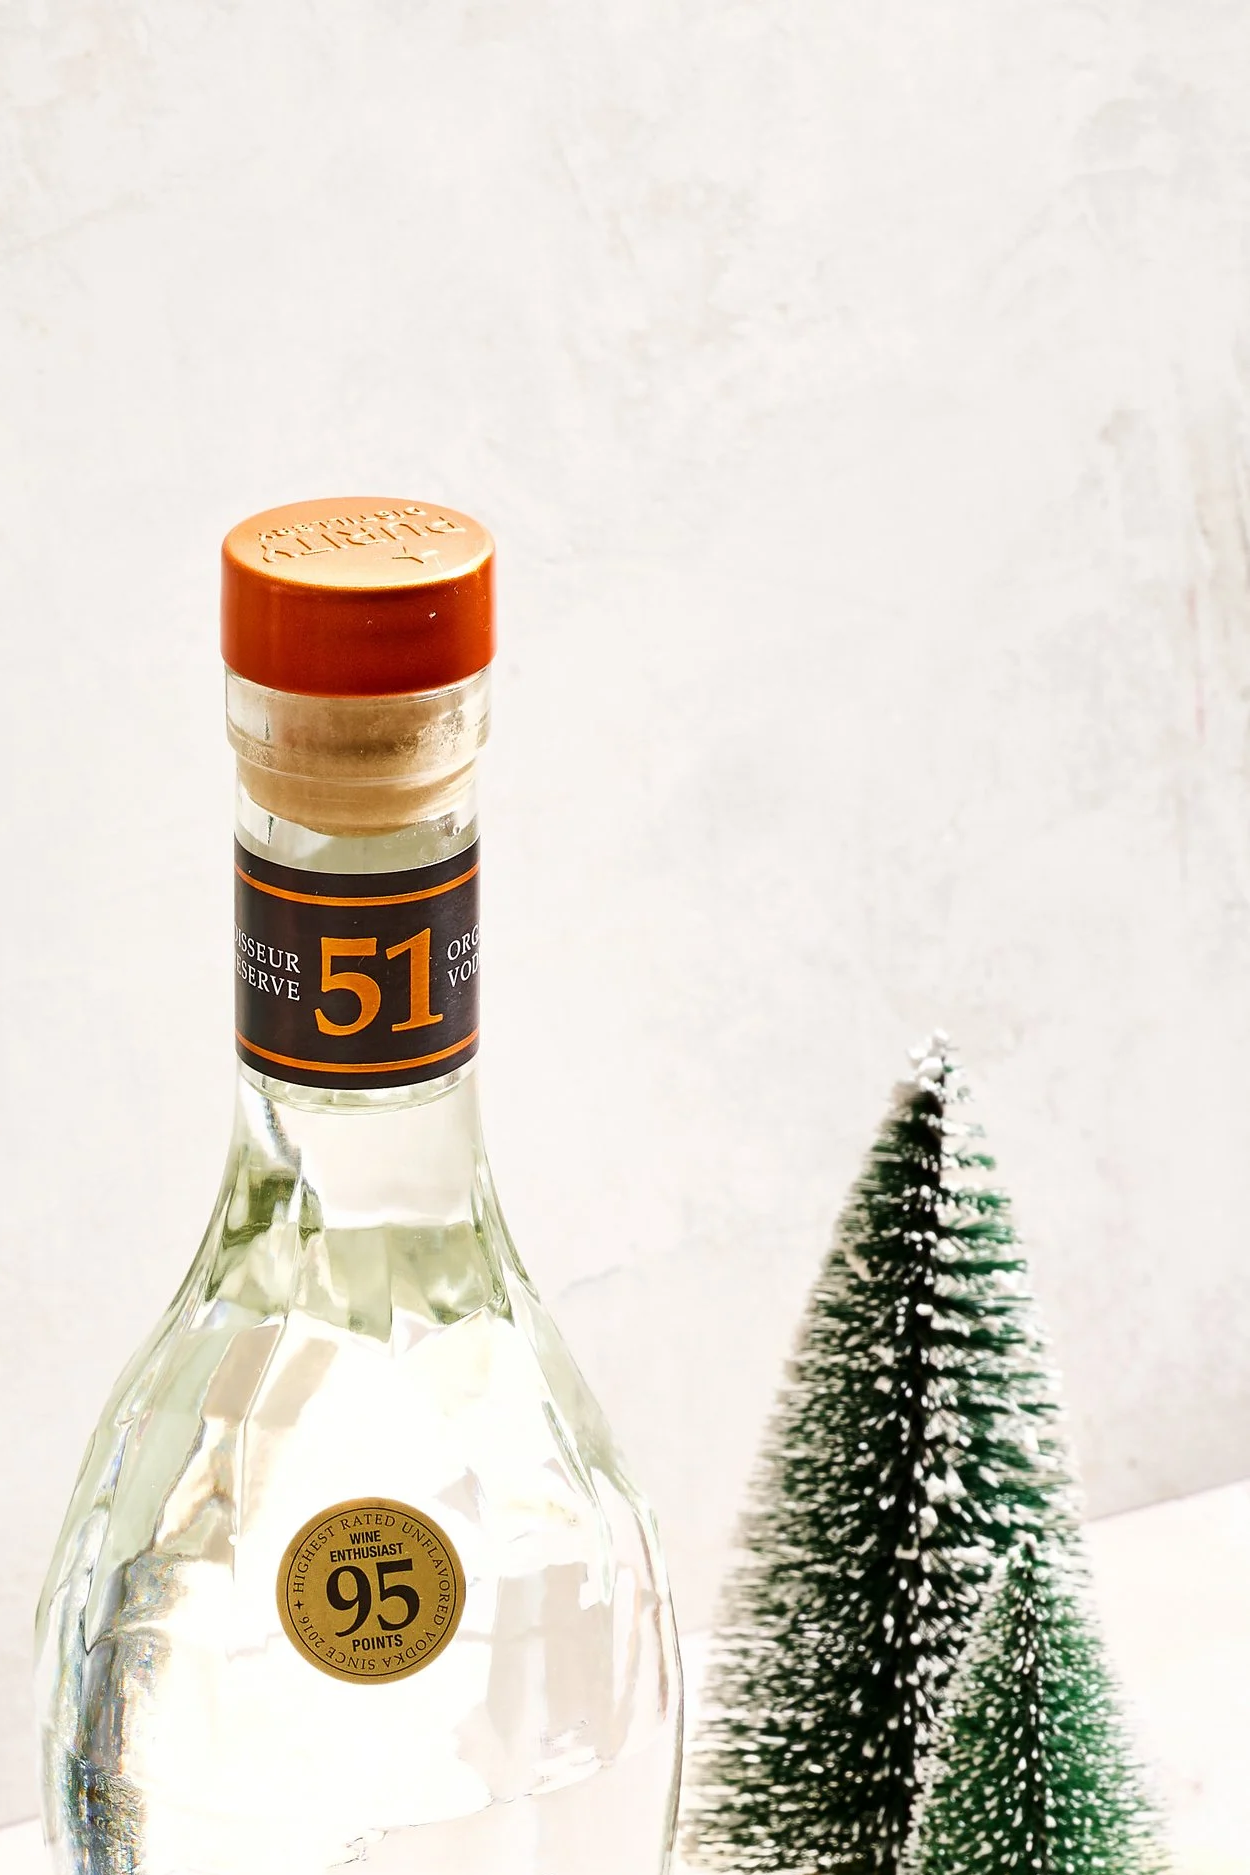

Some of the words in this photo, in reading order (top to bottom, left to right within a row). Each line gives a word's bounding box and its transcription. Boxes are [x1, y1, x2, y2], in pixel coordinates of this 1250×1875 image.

[262, 515, 466, 564] PURITY
[314, 927, 444, 1037] 51
[340, 1513, 396, 1531] RATED
[349, 1530, 382, 1545] WINE
[293, 1526, 336, 1593] HIGHEST
[329, 1542, 404, 1563] ENTHUSIAST
[401, 1521, 451, 1627] UNFLAVORED
[326, 1558, 421, 1638] 95
[325, 1646, 376, 1671] SINCE
[352, 1634, 403, 1652] POINTS
[382, 1629, 437, 1667] VODKA
